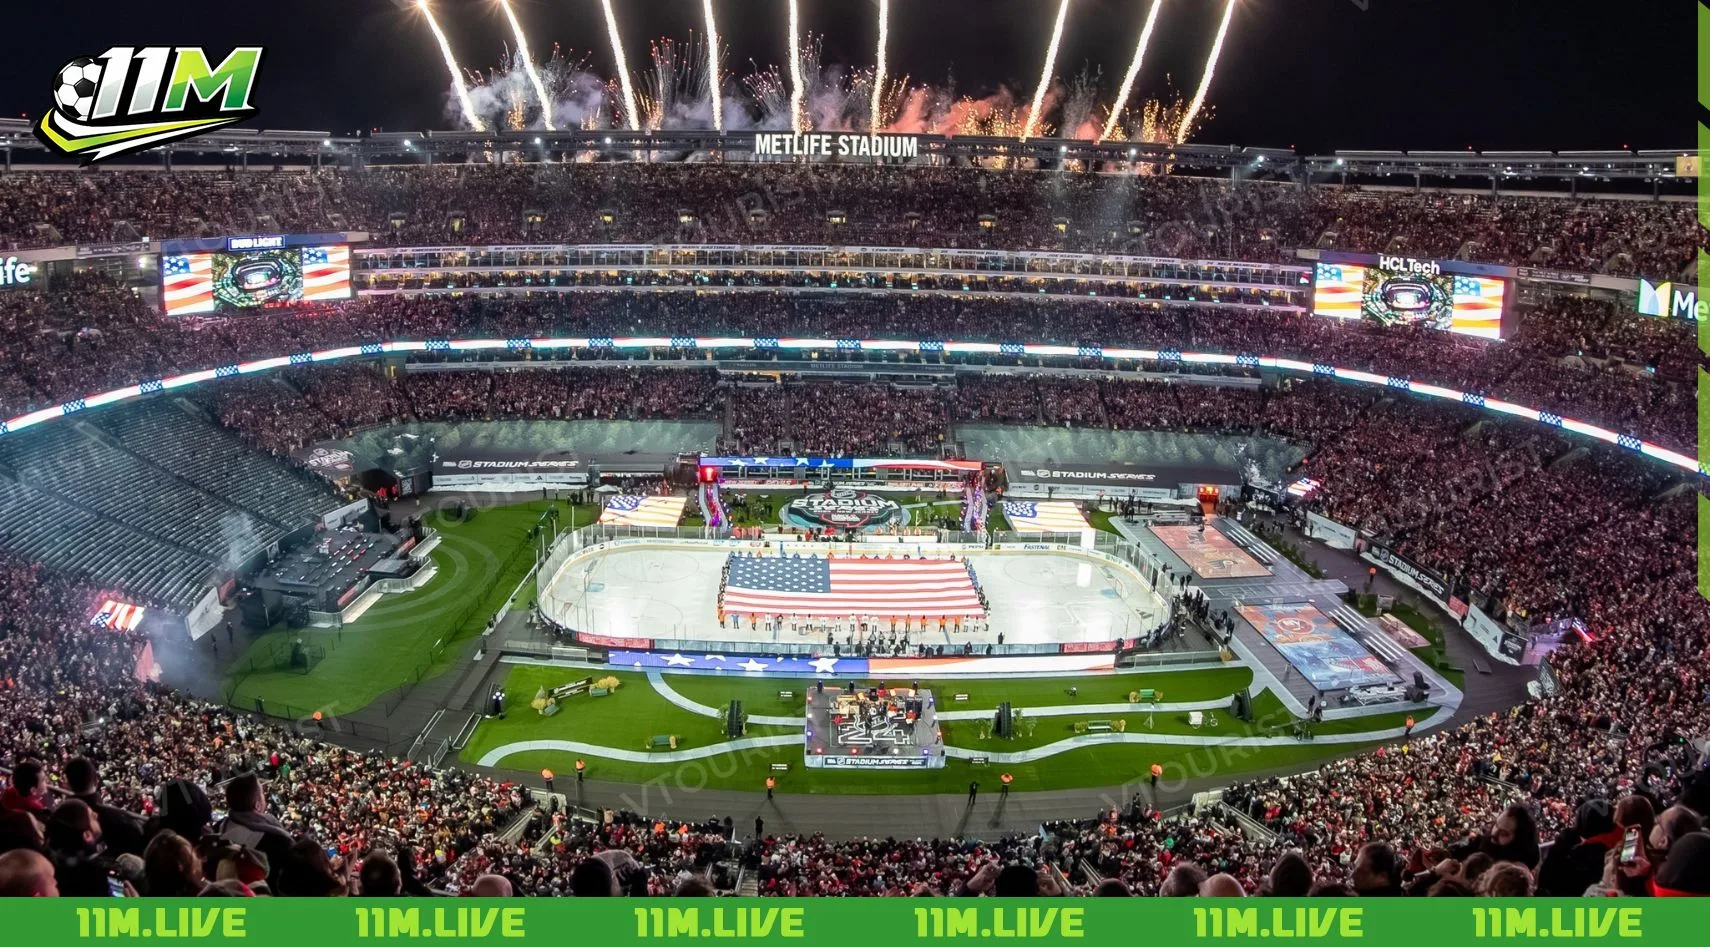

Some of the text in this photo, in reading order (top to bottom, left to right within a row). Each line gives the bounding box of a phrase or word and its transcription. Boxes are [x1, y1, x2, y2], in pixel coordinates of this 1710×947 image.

[756, 134, 918, 157] METLIFE STADIUM
[231, 237, 283, 249] BUD LIGHT
[0, 256, 31, 285] ife
[1379, 256, 1441, 275] HCLTech
[528, 460, 579, 468] SERIES
[1053, 472, 1157, 481] STADIUM SERIES
[791, 499, 900, 510] STADIUM
[1389, 555, 1444, 595] STADIUM SERIES
[845, 758, 880, 766] STADIUM
